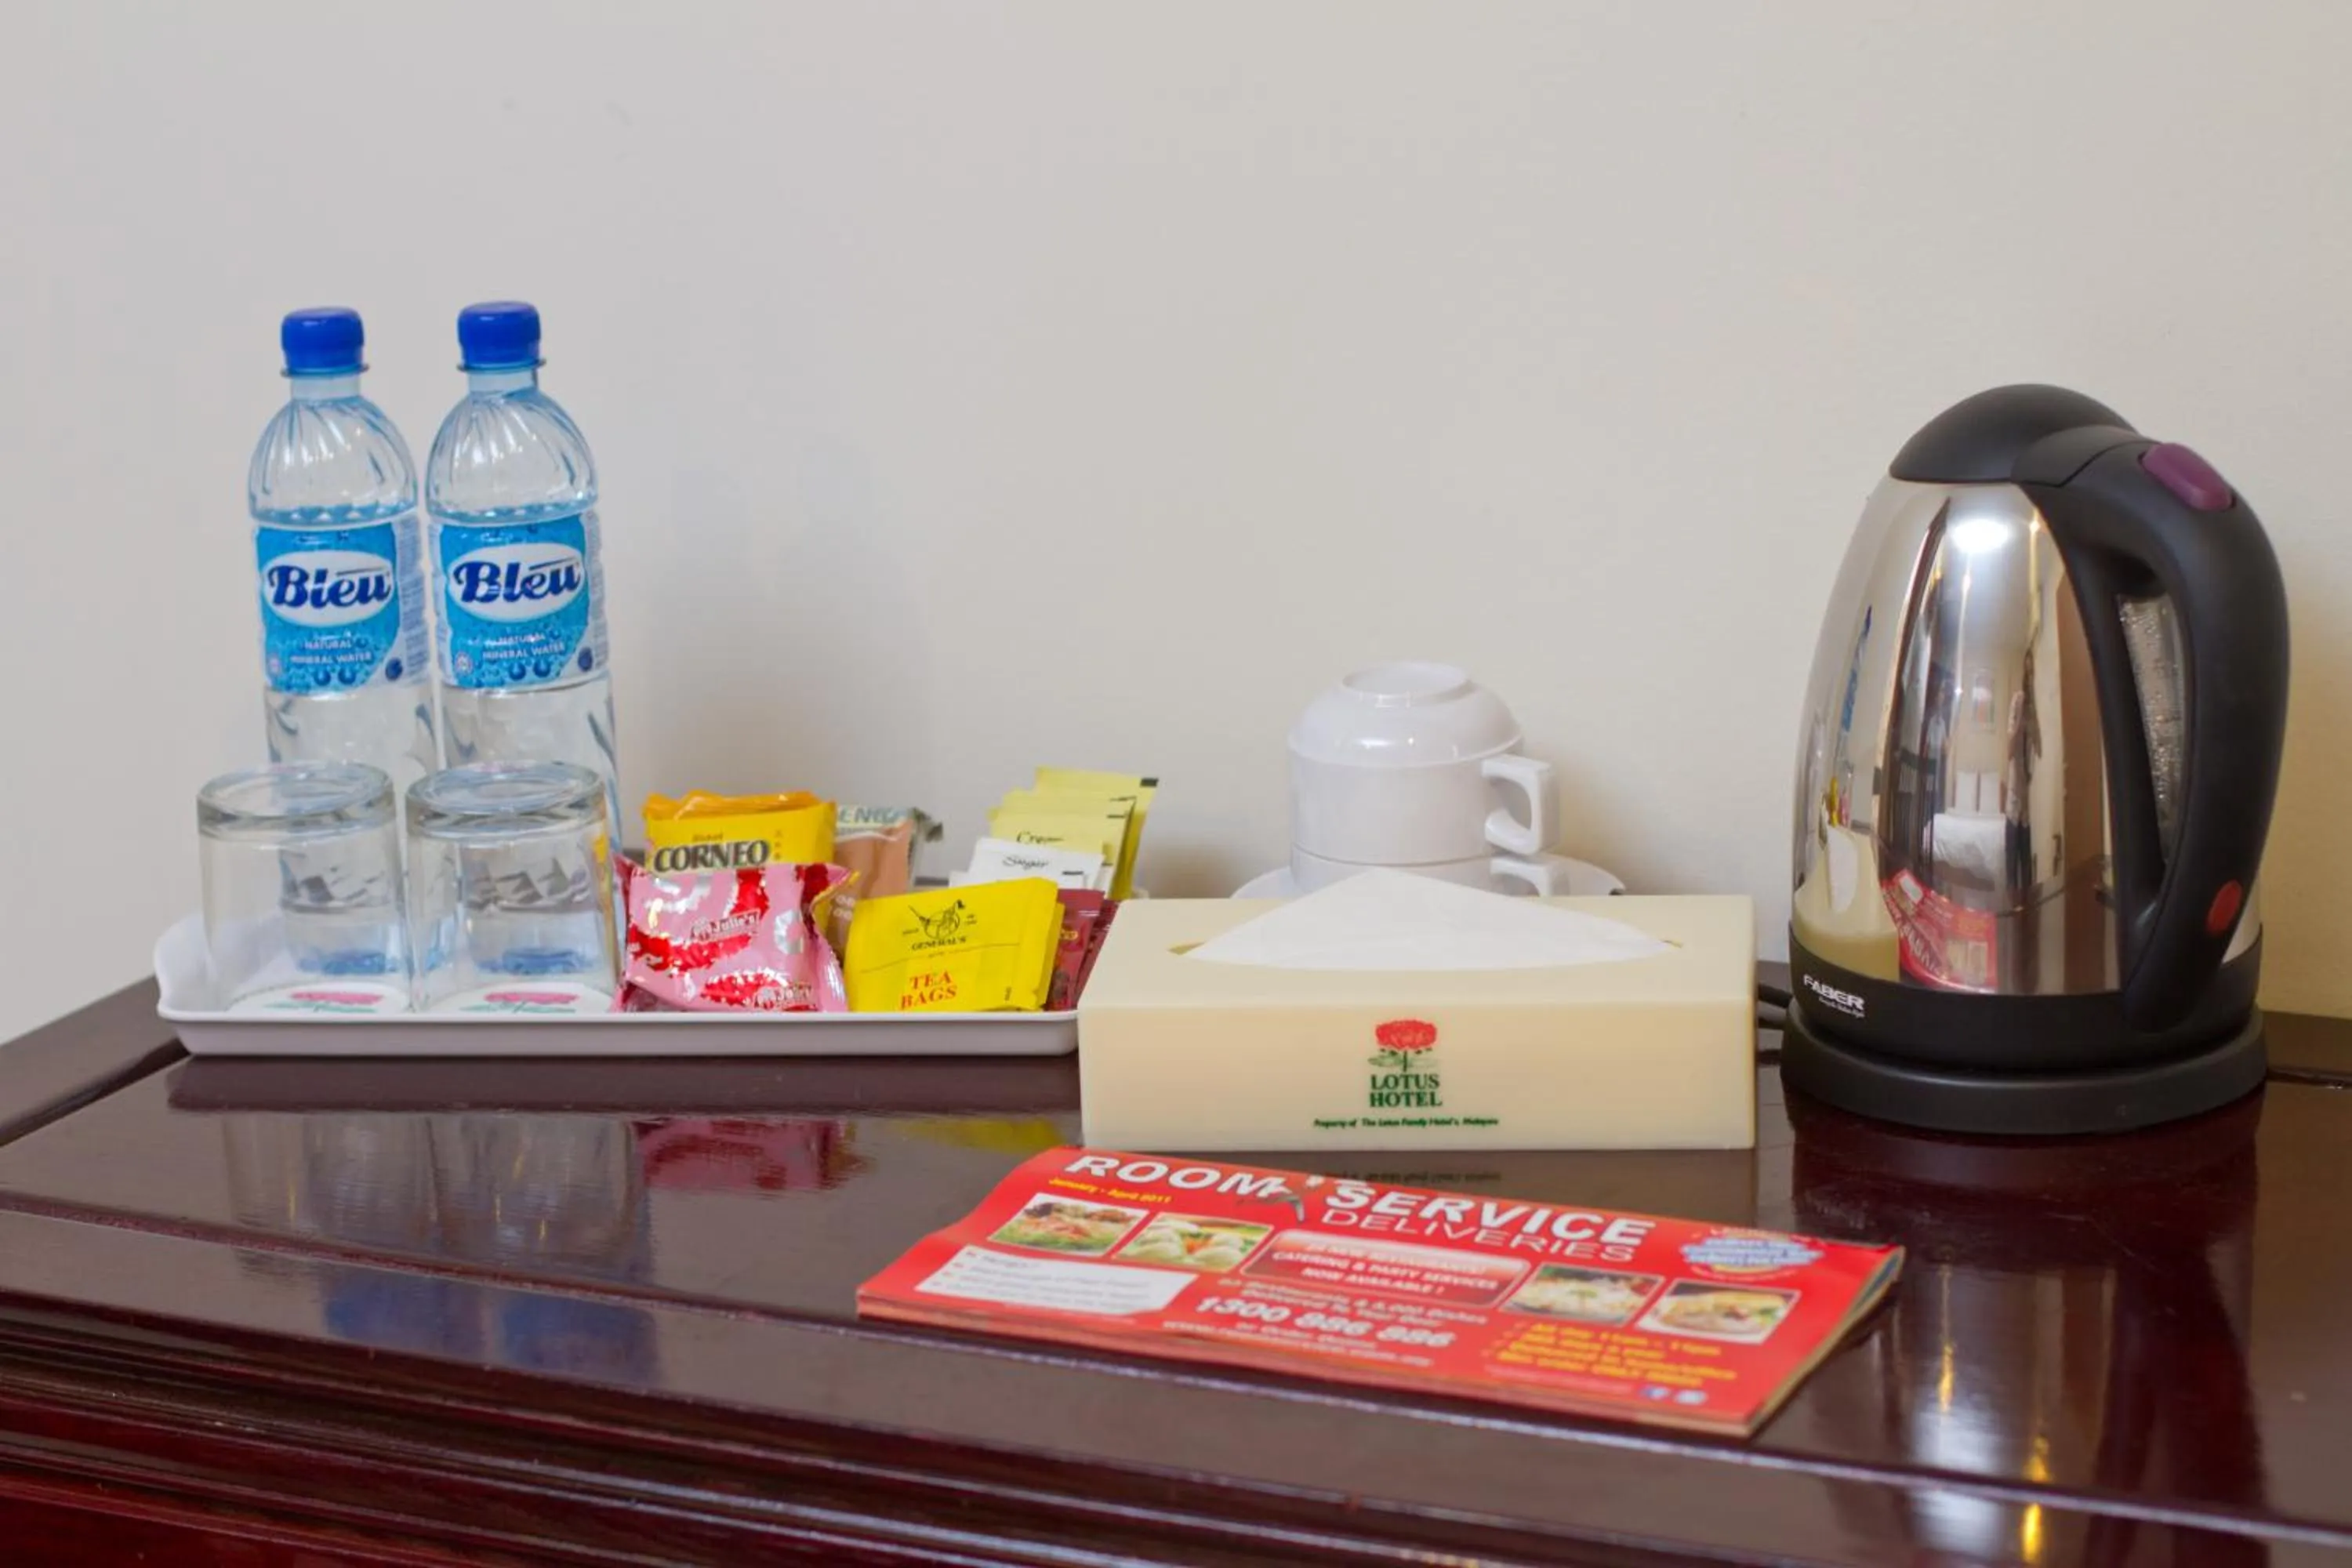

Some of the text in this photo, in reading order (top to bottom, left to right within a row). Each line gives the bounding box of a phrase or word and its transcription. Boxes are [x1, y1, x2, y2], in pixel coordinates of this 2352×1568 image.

[267, 565, 391, 608] Bleu
[453, 557, 581, 603] Bleu
[654, 840, 770, 873] CORNEO
[909, 970, 953, 990] TEA
[1804, 975, 1864, 1011] FABER
[901, 985, 957, 1011] BAGS
[1370, 1073, 1440, 1090] LOTUS
[1370, 1091, 1443, 1108] HOTEL
[1065, 1156, 1655, 1247] ROOM SERVICE
[1321, 1209, 1635, 1262] DELIVERIES
[1196, 1295, 1292, 1323] 1300
